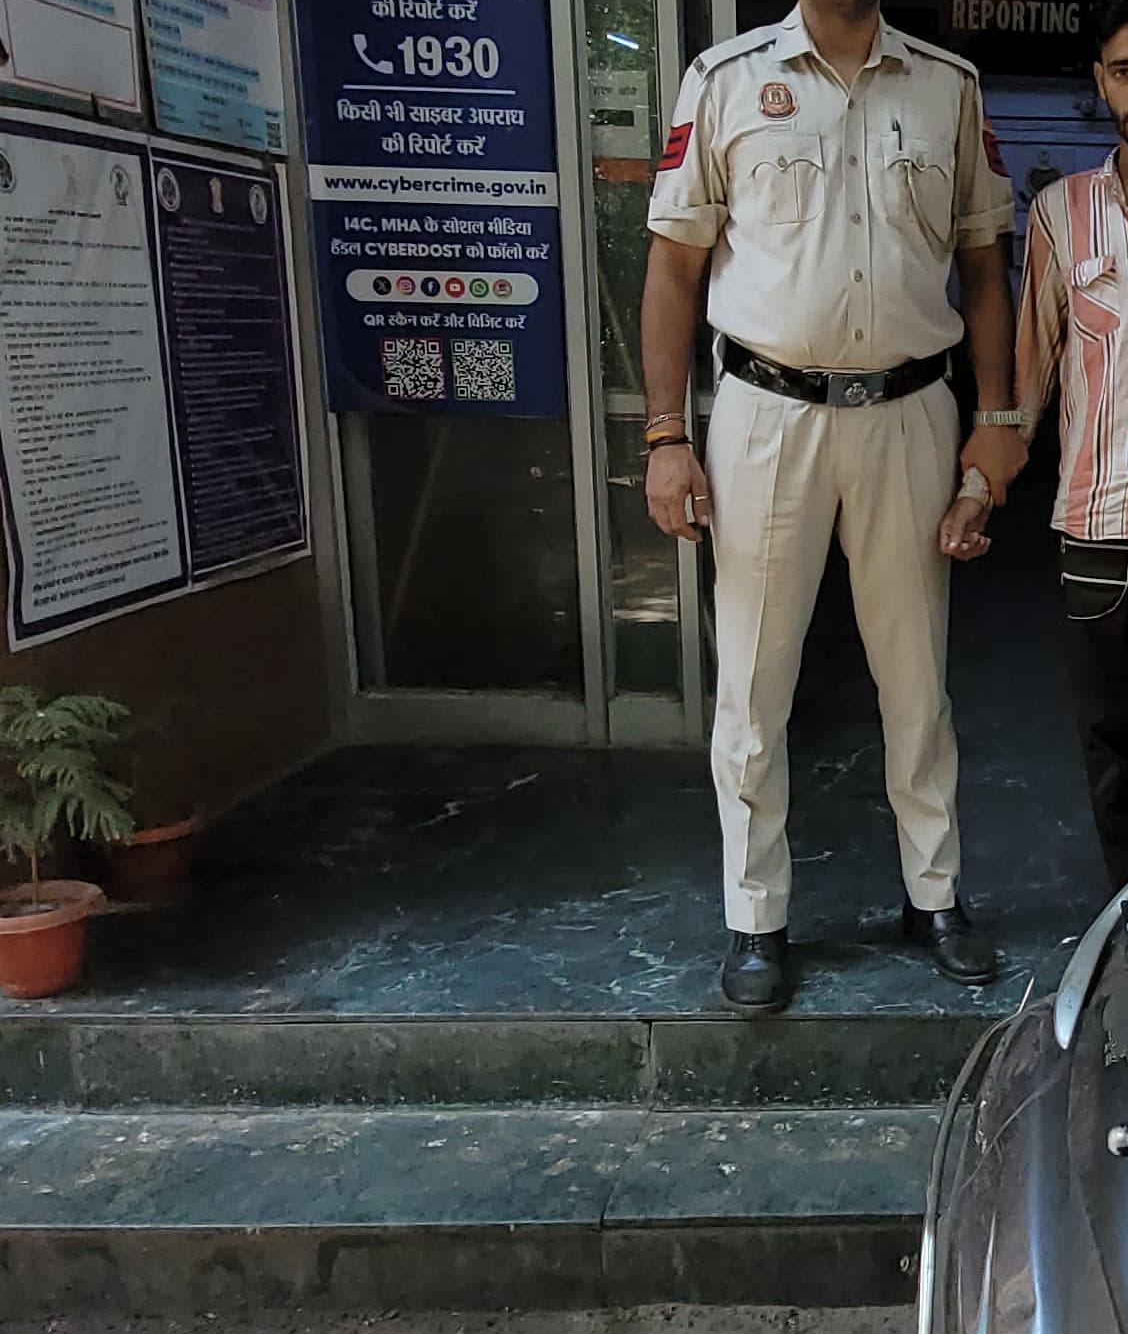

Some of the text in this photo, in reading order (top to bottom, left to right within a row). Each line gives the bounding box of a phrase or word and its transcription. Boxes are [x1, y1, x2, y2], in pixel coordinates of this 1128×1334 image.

[448, 0, 479, 22] करें
[397, 35, 500, 79] 1930
[336, 98, 526, 127] किसी भी साइबर अपराध
[381, 131, 487, 157] की रिपोर्ट करें
[323, 175, 547, 199] www.cybercrime.gov.in
[381, 218, 422, 233] MHA
[423, 216, 439, 233] के
[442, 216, 484, 235] सोशल
[364, 241, 462, 259] CYBERDOST
[465, 241, 485, 259] को
[525, 243, 550, 261] करें
